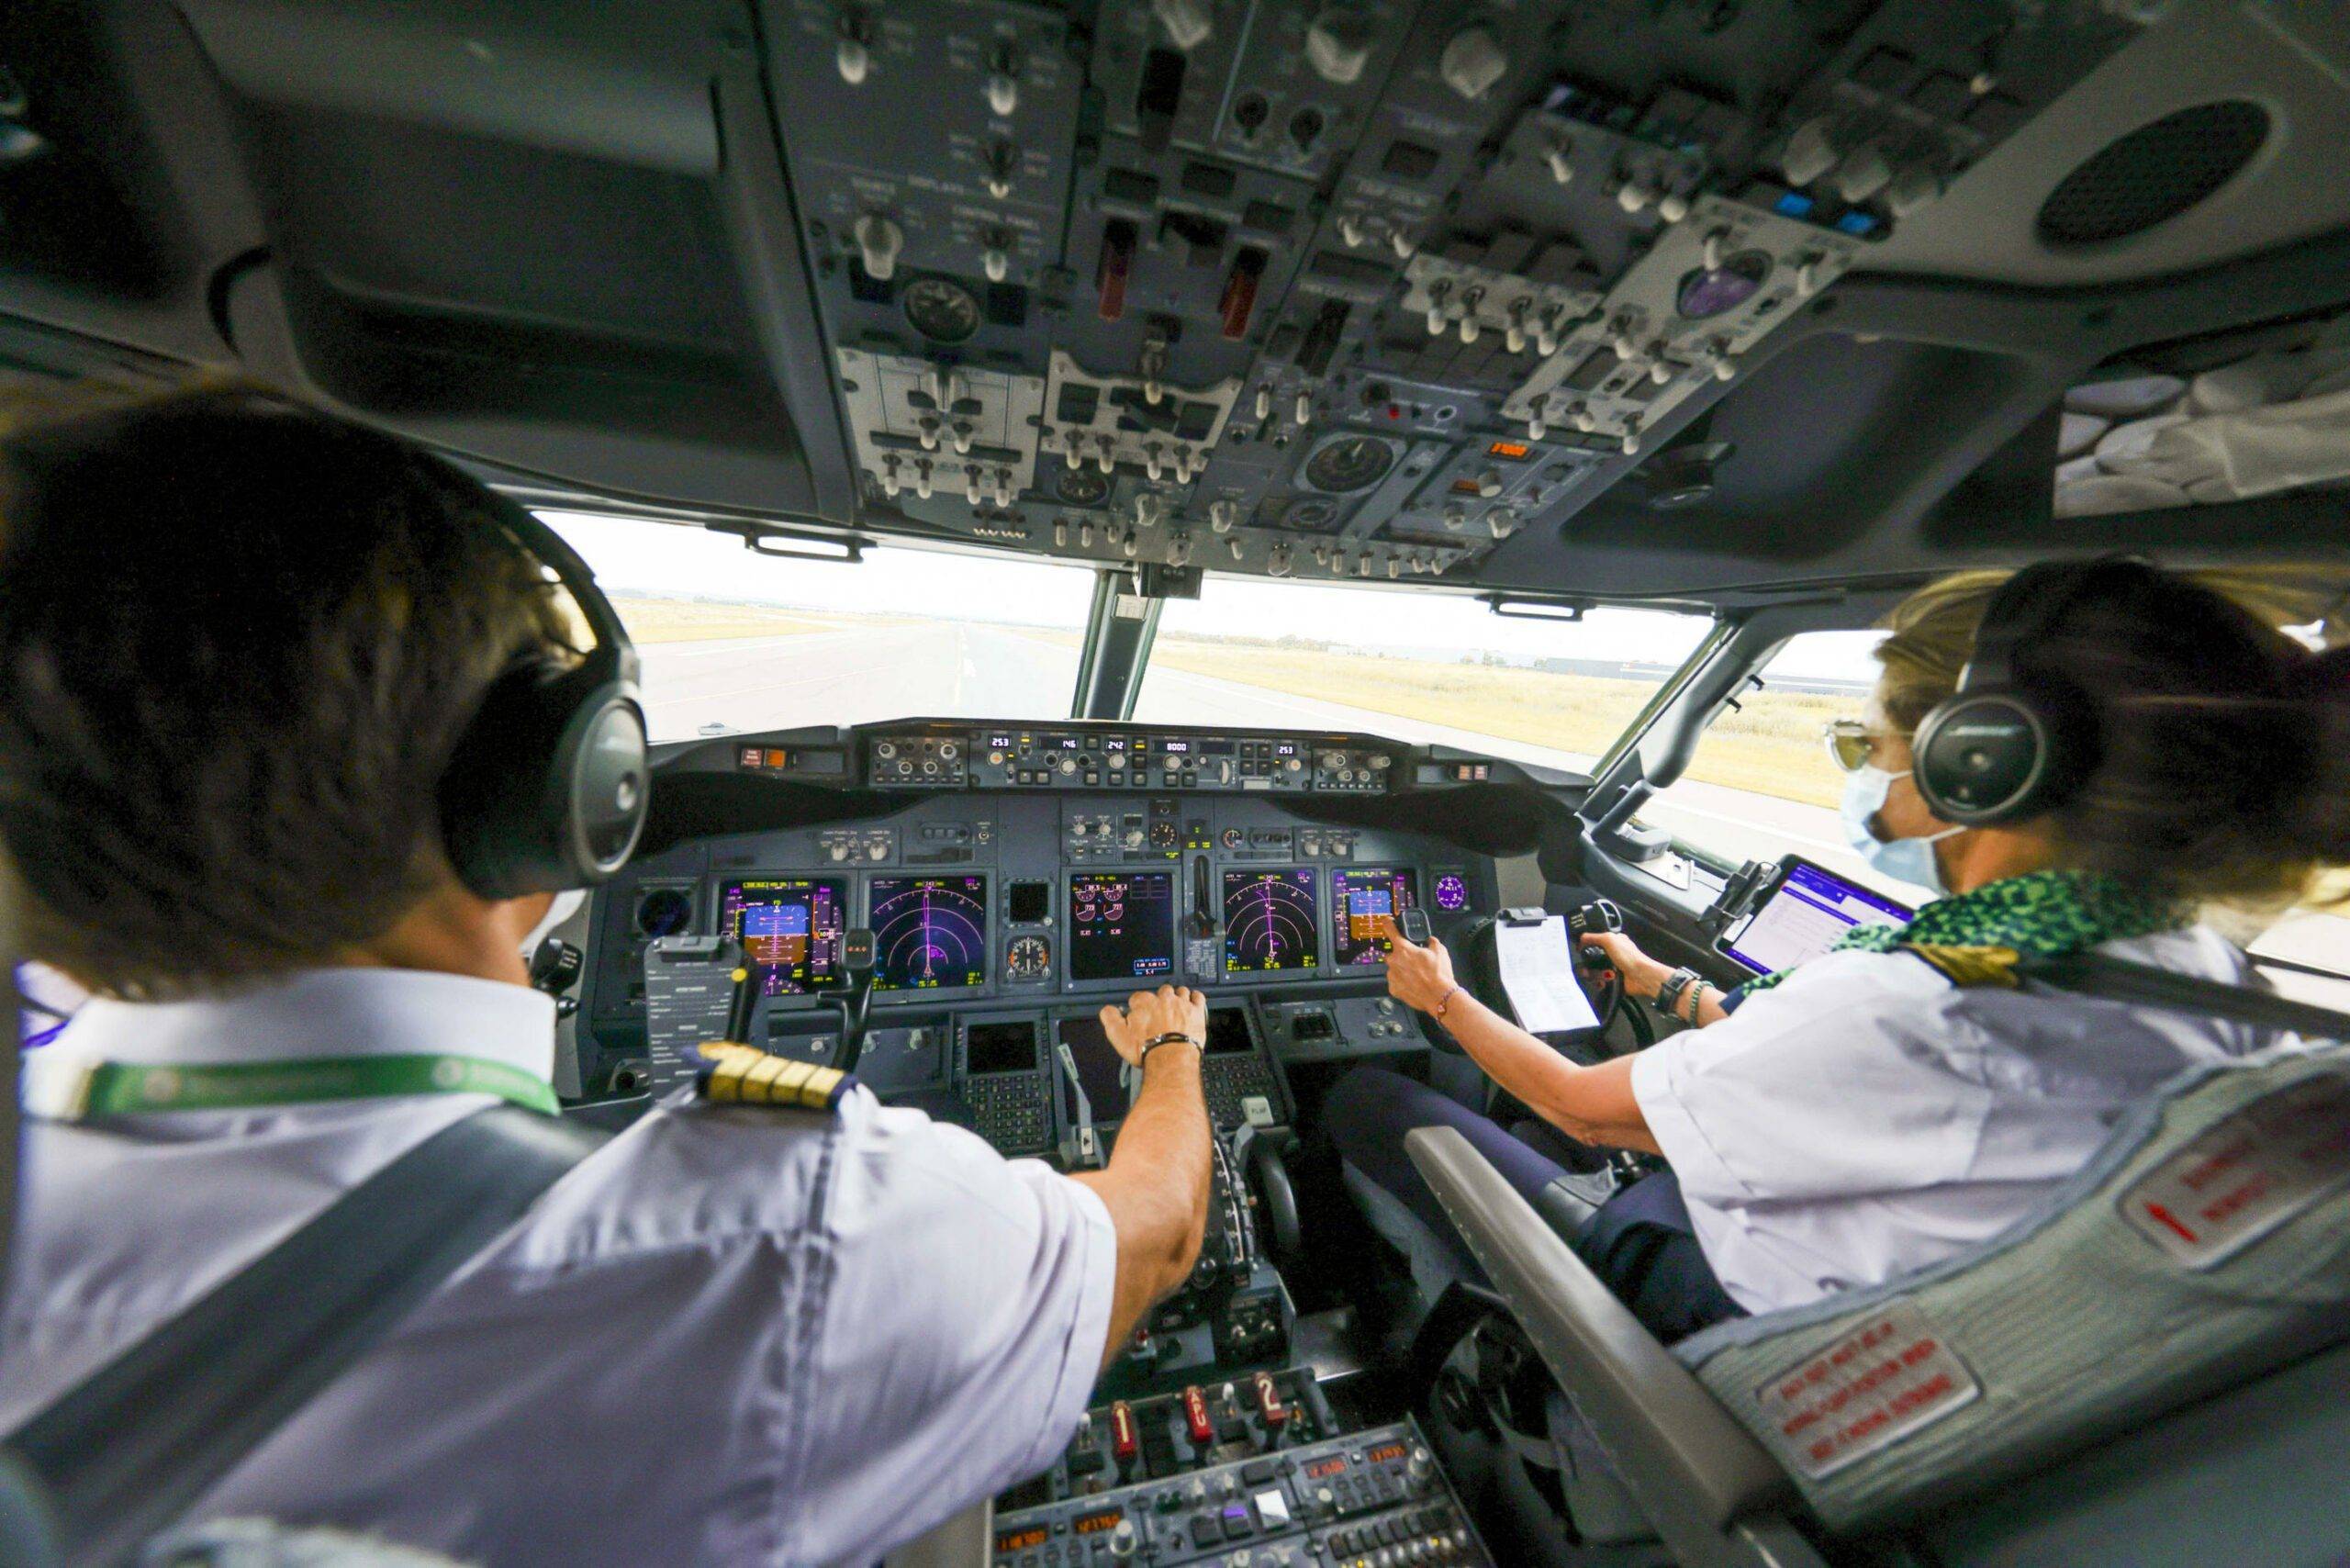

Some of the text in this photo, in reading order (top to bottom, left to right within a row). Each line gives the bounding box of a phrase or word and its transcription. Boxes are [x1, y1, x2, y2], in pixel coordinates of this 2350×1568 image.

[991, 737, 1010, 747] 253
[1062, 740, 1076, 748] 146
[1108, 741, 1124, 749] 242
[1167, 742, 1187, 752] 8000
[1279, 745, 1293, 755] 253
[1259, 1378, 1282, 1412] 2
[1191, 1391, 1207, 1428] APU
[1115, 1407, 1129, 1444] 1
